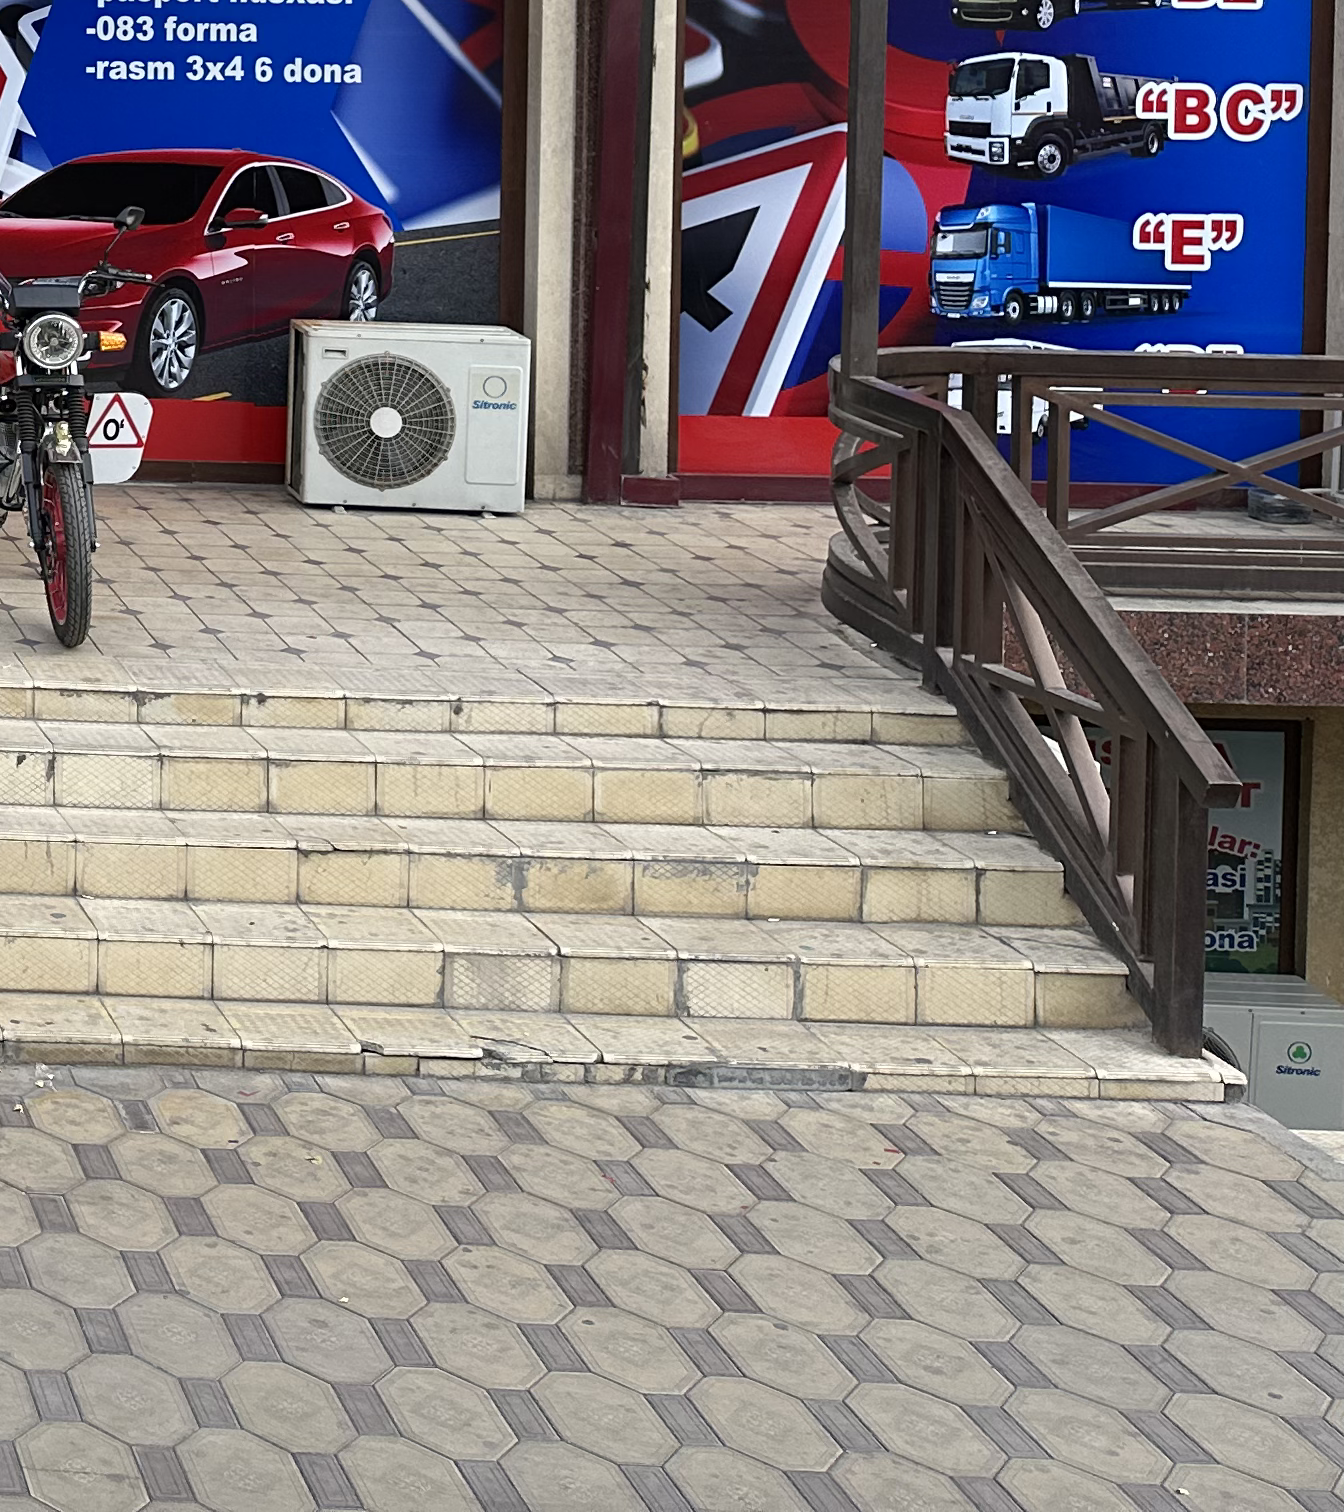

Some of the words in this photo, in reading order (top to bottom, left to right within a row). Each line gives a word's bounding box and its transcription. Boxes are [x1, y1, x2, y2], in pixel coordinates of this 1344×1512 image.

[86, 16, 155, 42] -083
[164, 16, 258, 42] forma
[85, 58, 175, 81] -rasm
[185, 56, 244, 82] 3x4
[254, 56, 274, 82] 6
[283, 56, 363, 84] dona
[472, 400, 517, 410] Sitronic
[1275, 1065, 1321, 1077] Sitronic
